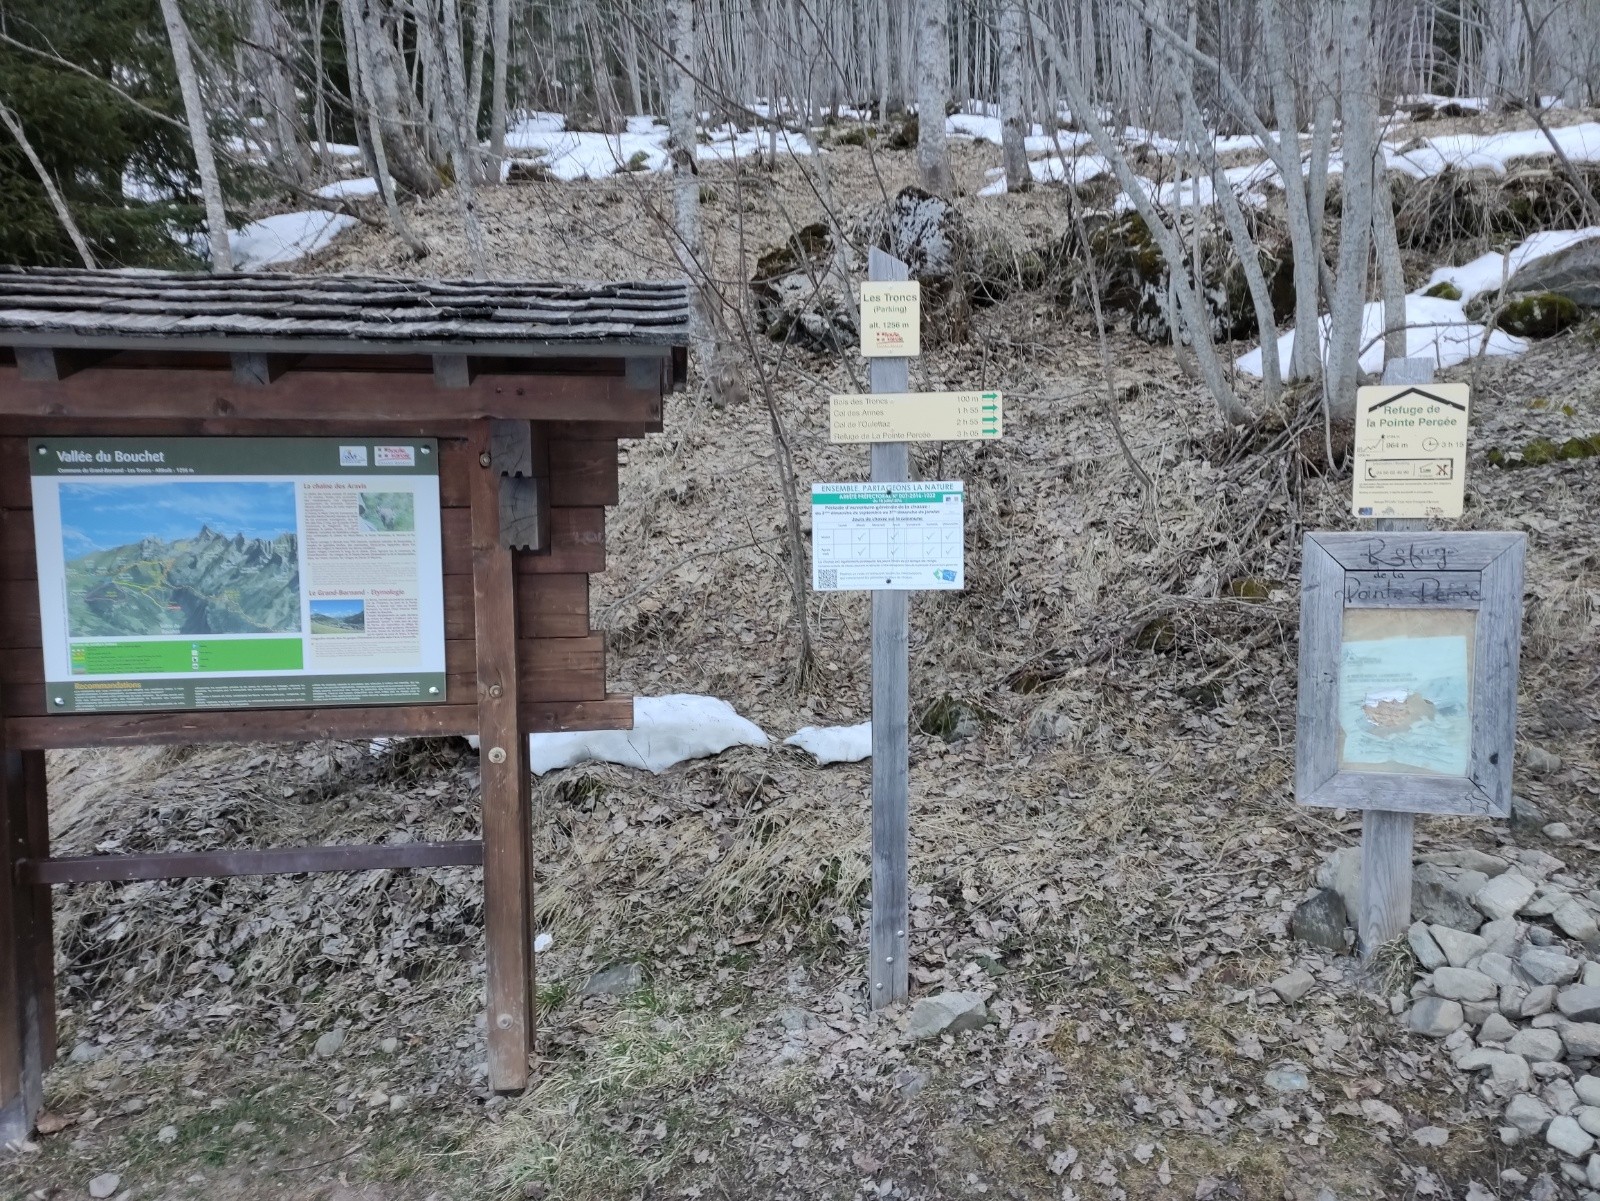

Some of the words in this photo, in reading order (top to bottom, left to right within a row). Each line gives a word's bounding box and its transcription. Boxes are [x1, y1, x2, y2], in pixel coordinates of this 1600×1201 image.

[864, 294, 881, 302] Les
[884, 293, 917, 302] Troncs
[873, 306, 907, 314] (Parking)
[957, 395, 970, 403] 100
[1384, 405, 1424, 416] Refuge
[1427, 405, 1441, 414] de
[833, 421, 846, 429] Col
[956, 418, 961, 426] 2
[1366, 419, 1376, 428] la
[1379, 418, 1415, 427] Pointe
[1419, 416, 1457, 426] Percée
[882, 431, 905, 439] Pointe
[56, 450, 93, 463] Vallée
[95, 450, 112, 463] du
[114, 450, 165, 463] Bouchet
[863, 484, 911, 492] PARTAGEONS
[924, 483, 954, 491] NATURE
[1373, 567, 1387, 579] de
[1393, 571, 1405, 579] la
[74, 682, 142, 690] Recommandations
